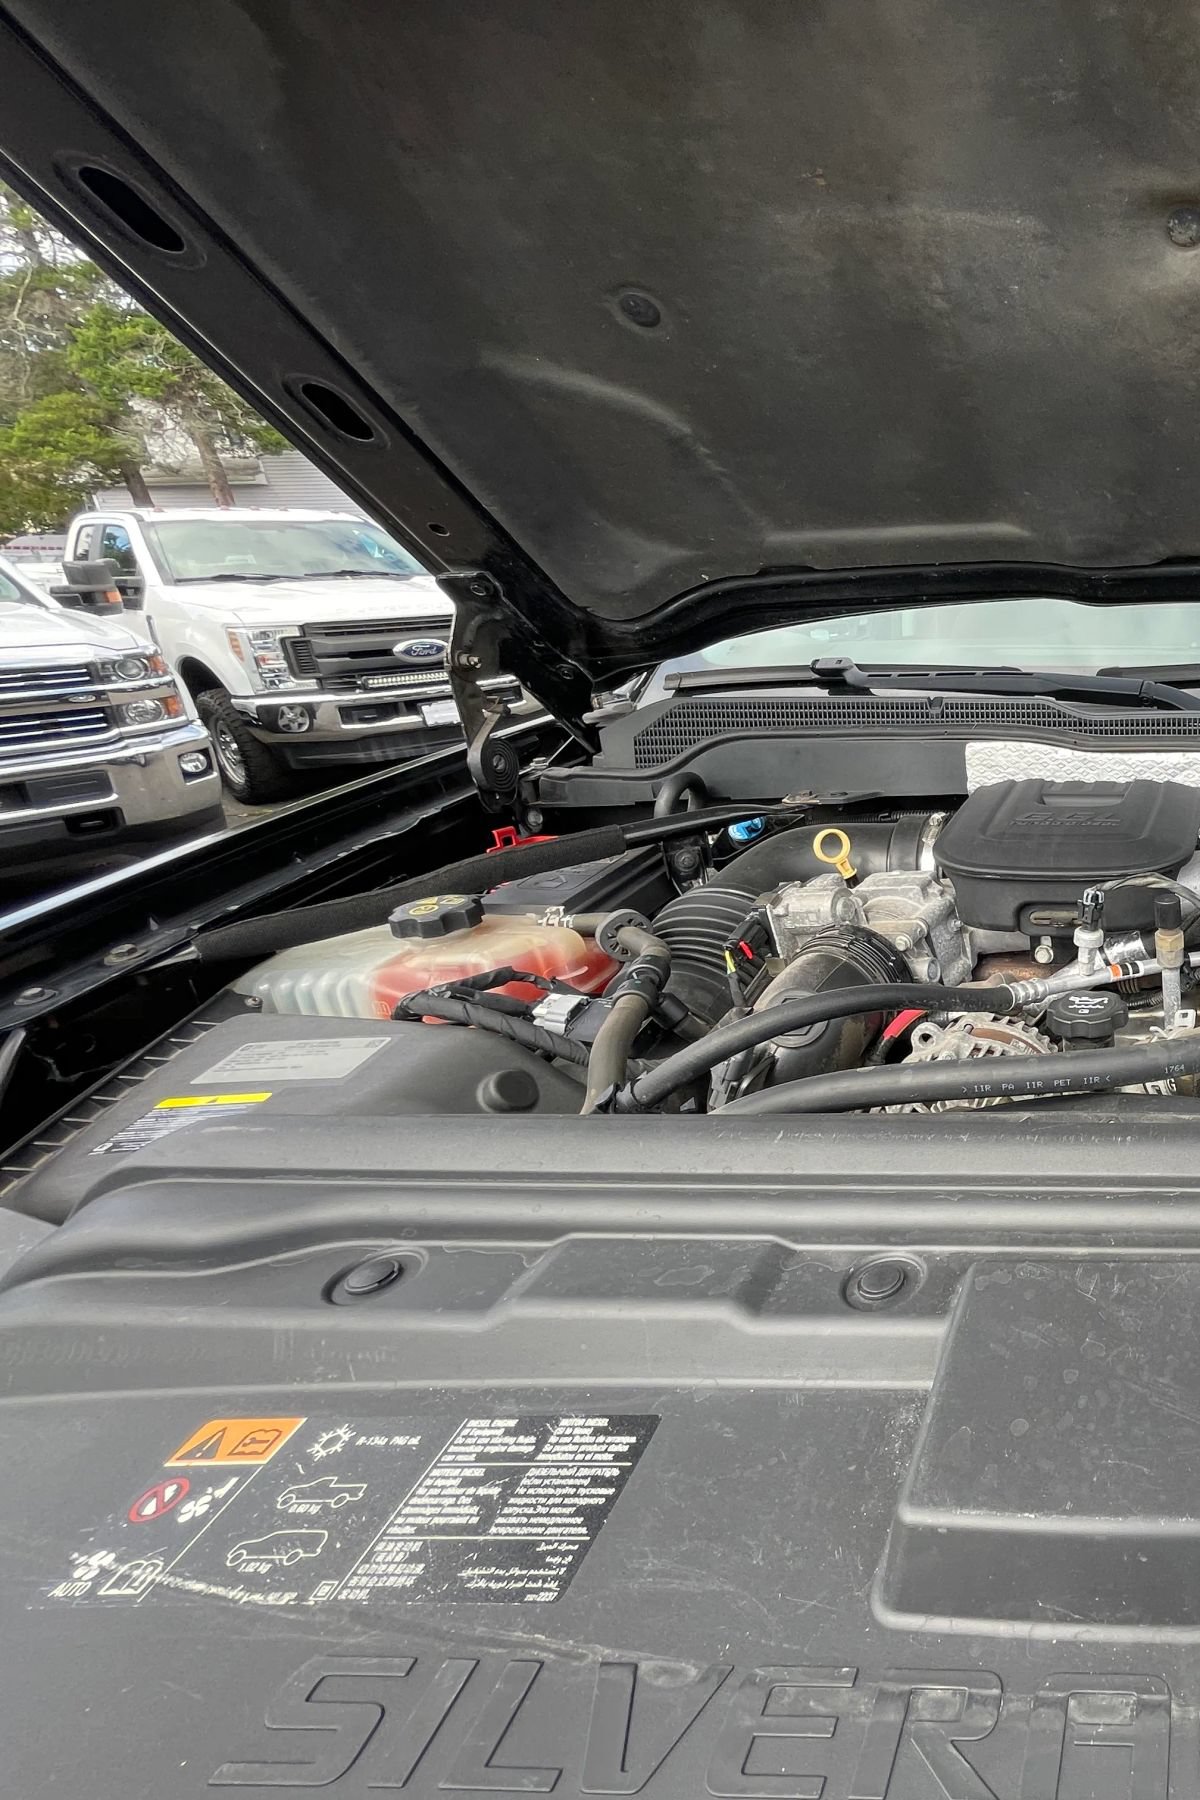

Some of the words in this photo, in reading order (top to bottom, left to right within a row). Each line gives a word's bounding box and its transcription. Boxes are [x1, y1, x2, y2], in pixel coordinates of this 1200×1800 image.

[1002, 1083, 1015, 1091] PA
[1054, 1079, 1072, 1088] PET
[1164, 1063, 1185, 1074] 1764
[47, 1582, 92, 1597] AUTO
